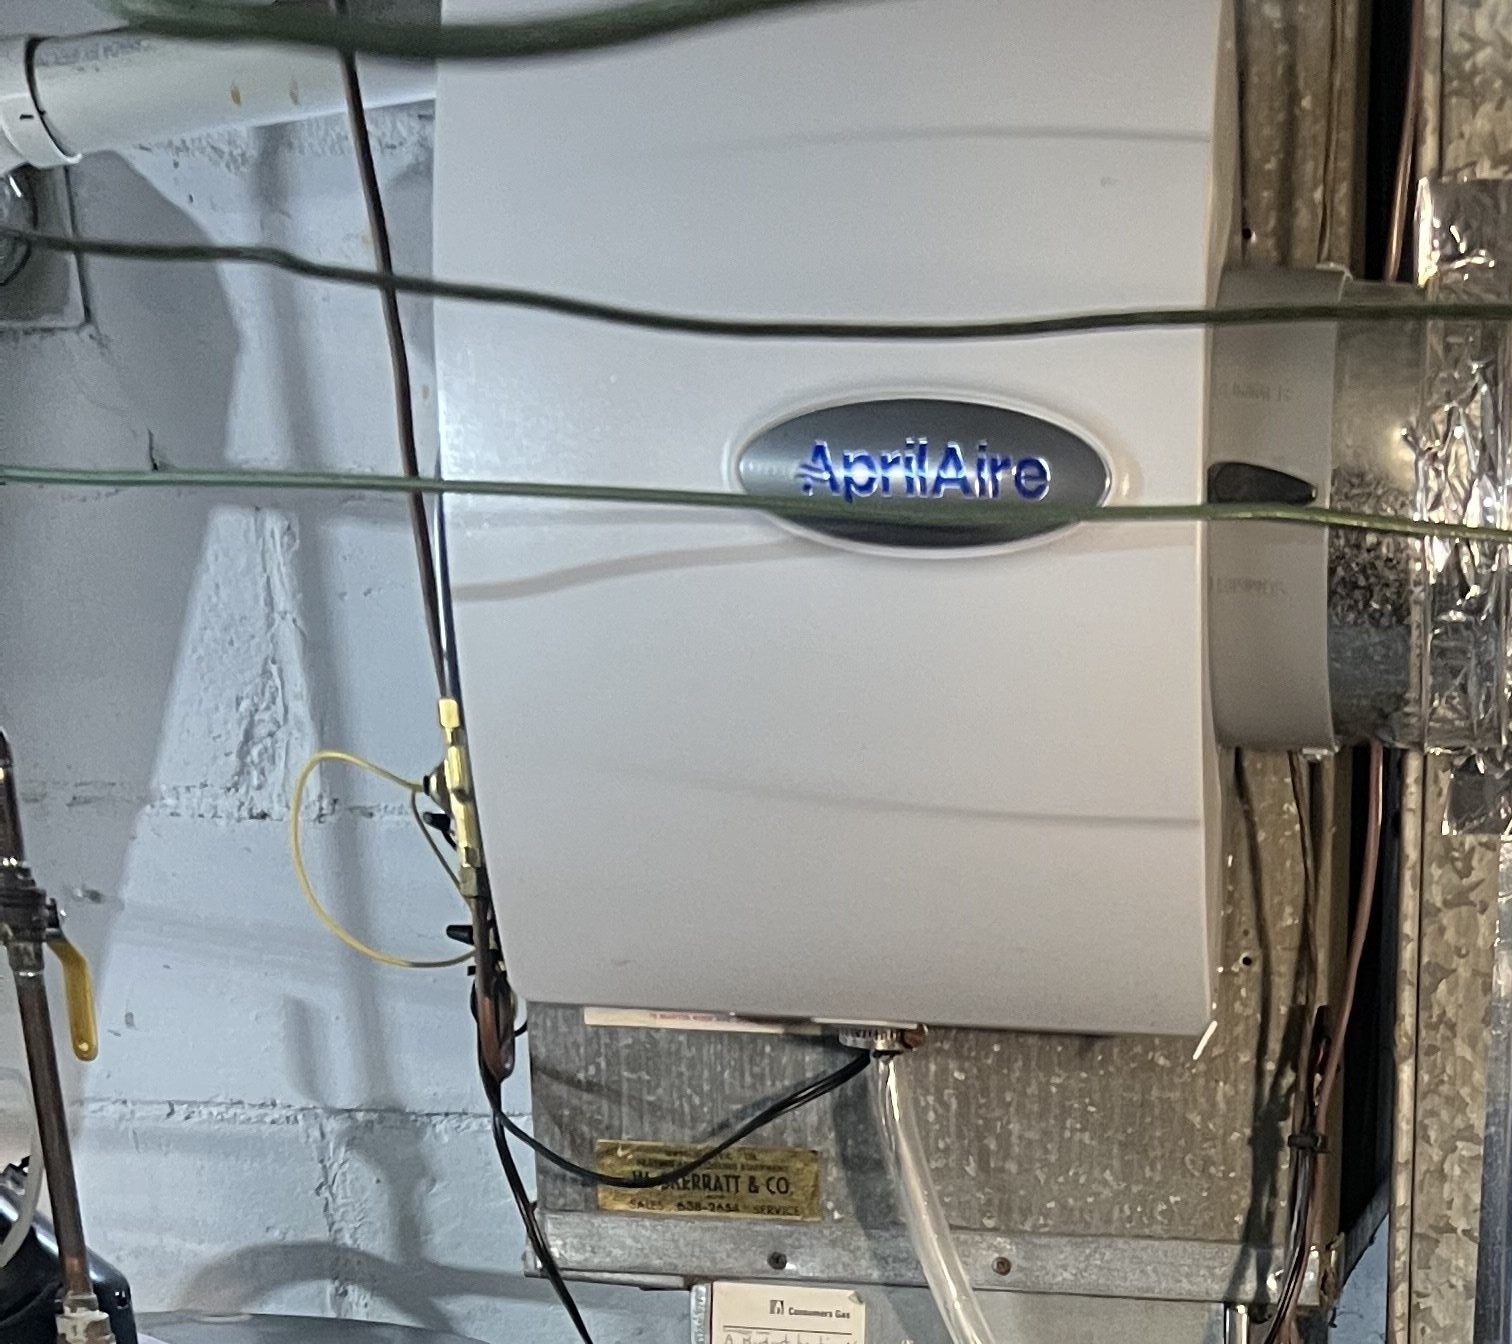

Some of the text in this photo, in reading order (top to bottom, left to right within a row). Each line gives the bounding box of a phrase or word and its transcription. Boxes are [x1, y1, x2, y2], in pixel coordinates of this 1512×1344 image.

[797, 437, 1051, 502] AprilAire
[748, 1176, 759, 1194] &
[752, 1205, 799, 1216] SERVICE
